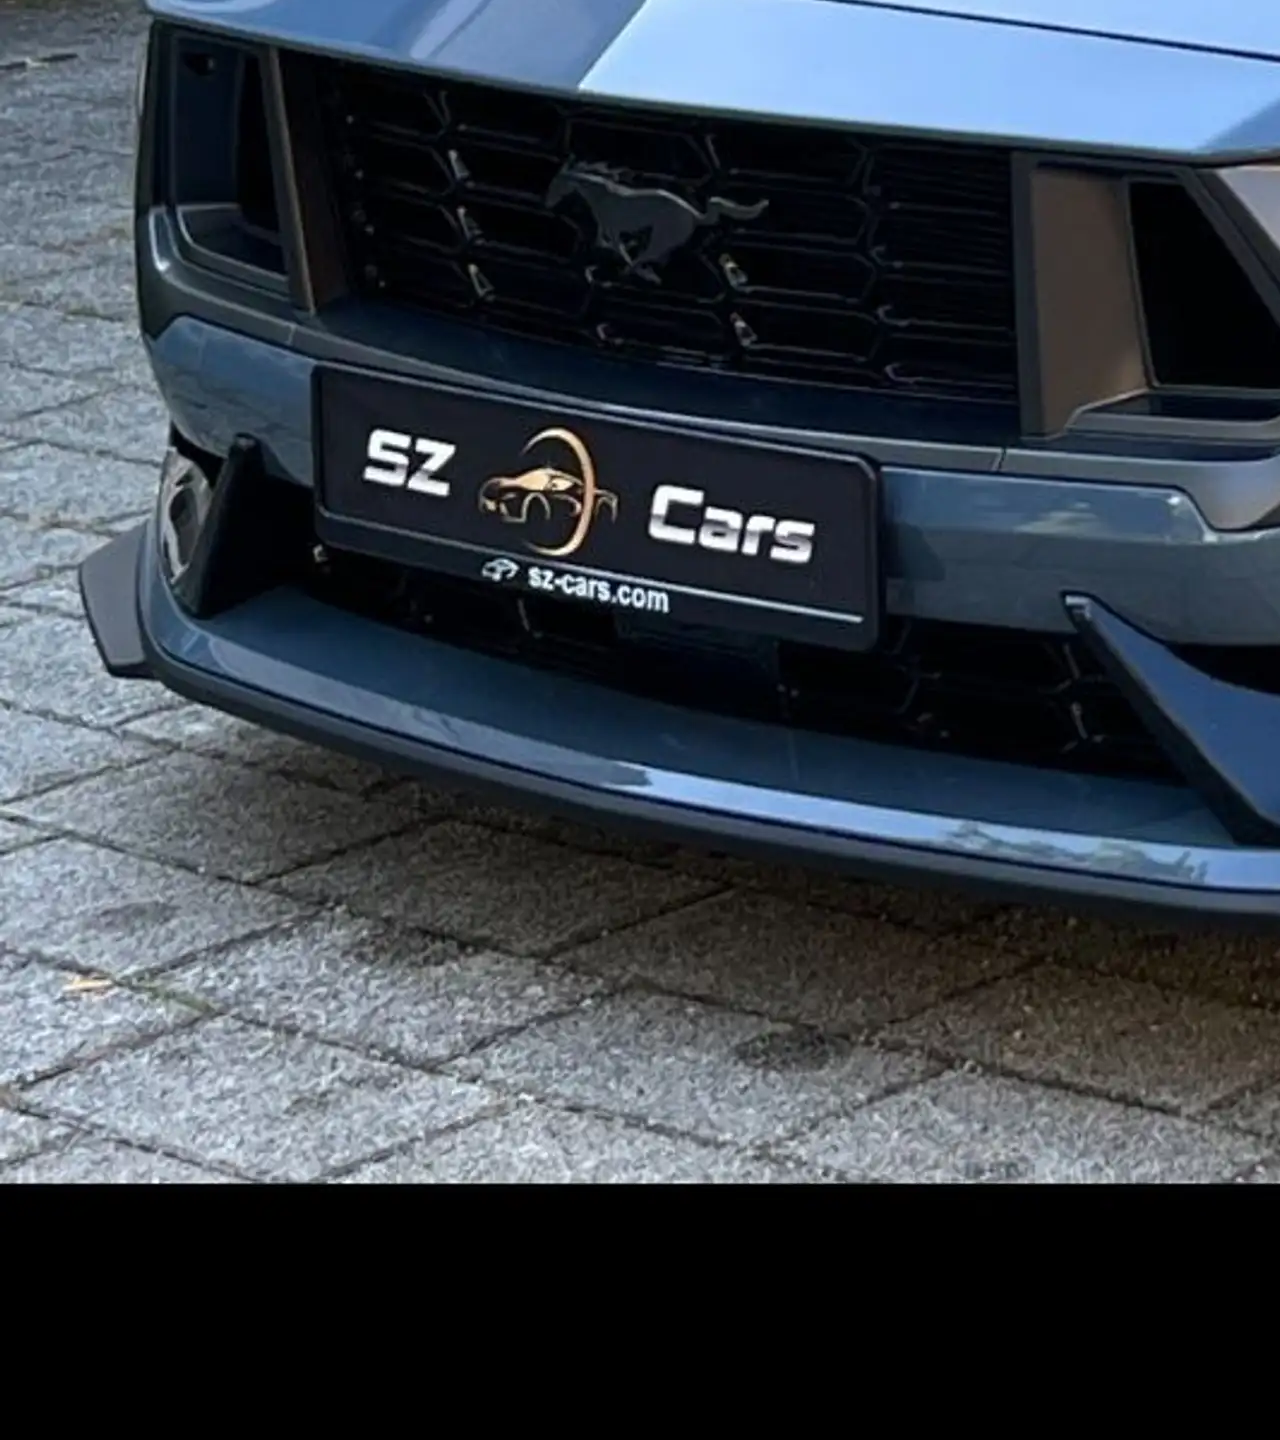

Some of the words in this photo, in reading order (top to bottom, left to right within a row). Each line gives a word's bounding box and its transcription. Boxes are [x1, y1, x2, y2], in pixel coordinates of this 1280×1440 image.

[363, 429, 456, 496] SZ
[648, 485, 815, 563] Cars
[528, 565, 669, 613] sz-cars.com
